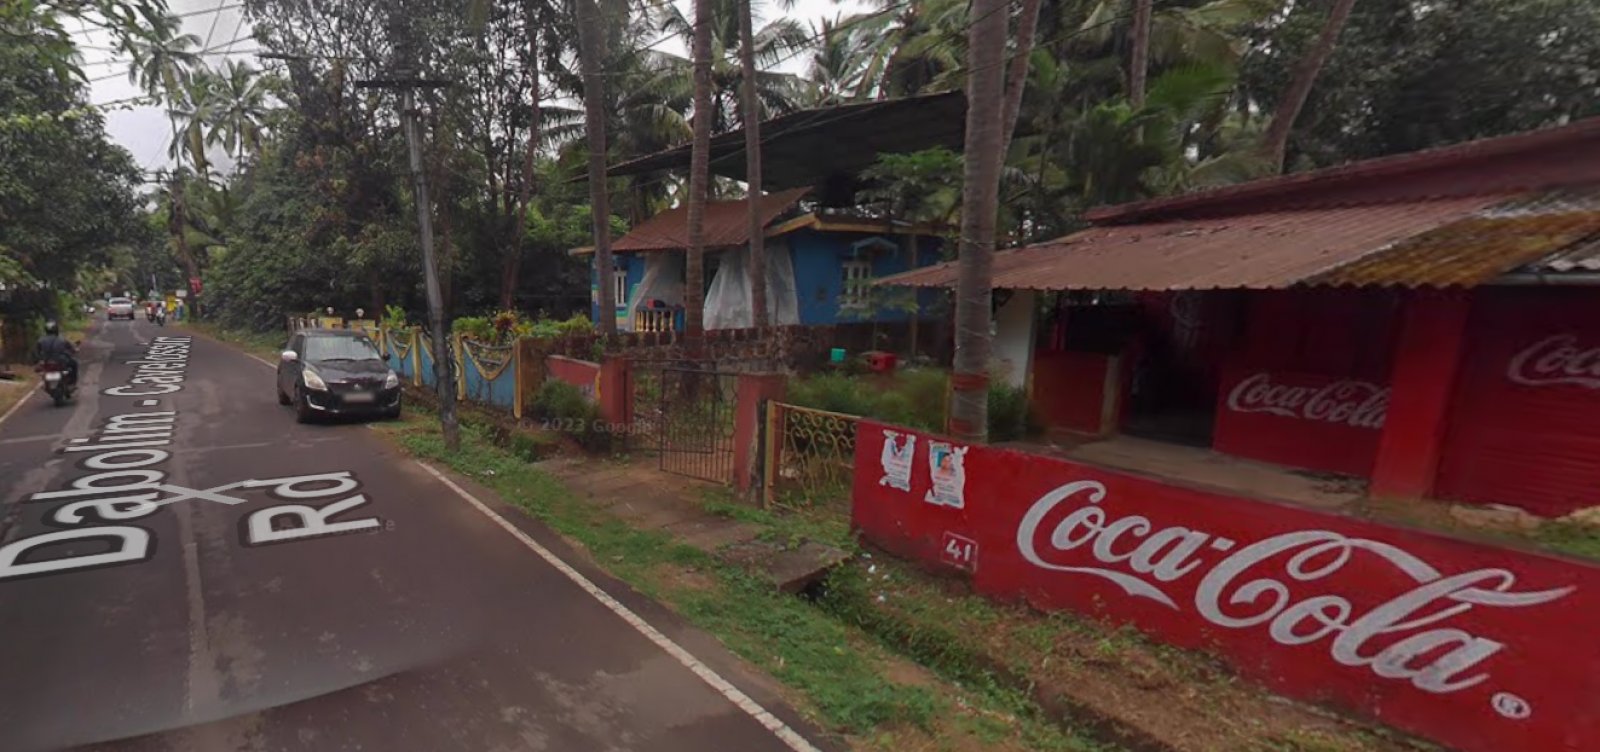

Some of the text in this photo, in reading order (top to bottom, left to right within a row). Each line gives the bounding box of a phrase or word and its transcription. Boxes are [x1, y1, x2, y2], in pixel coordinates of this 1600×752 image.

[1508, 334, 1600, 389] Coc
[946, 539, 971, 561] 41
[1017, 480, 1576, 692] Coca-Cola
